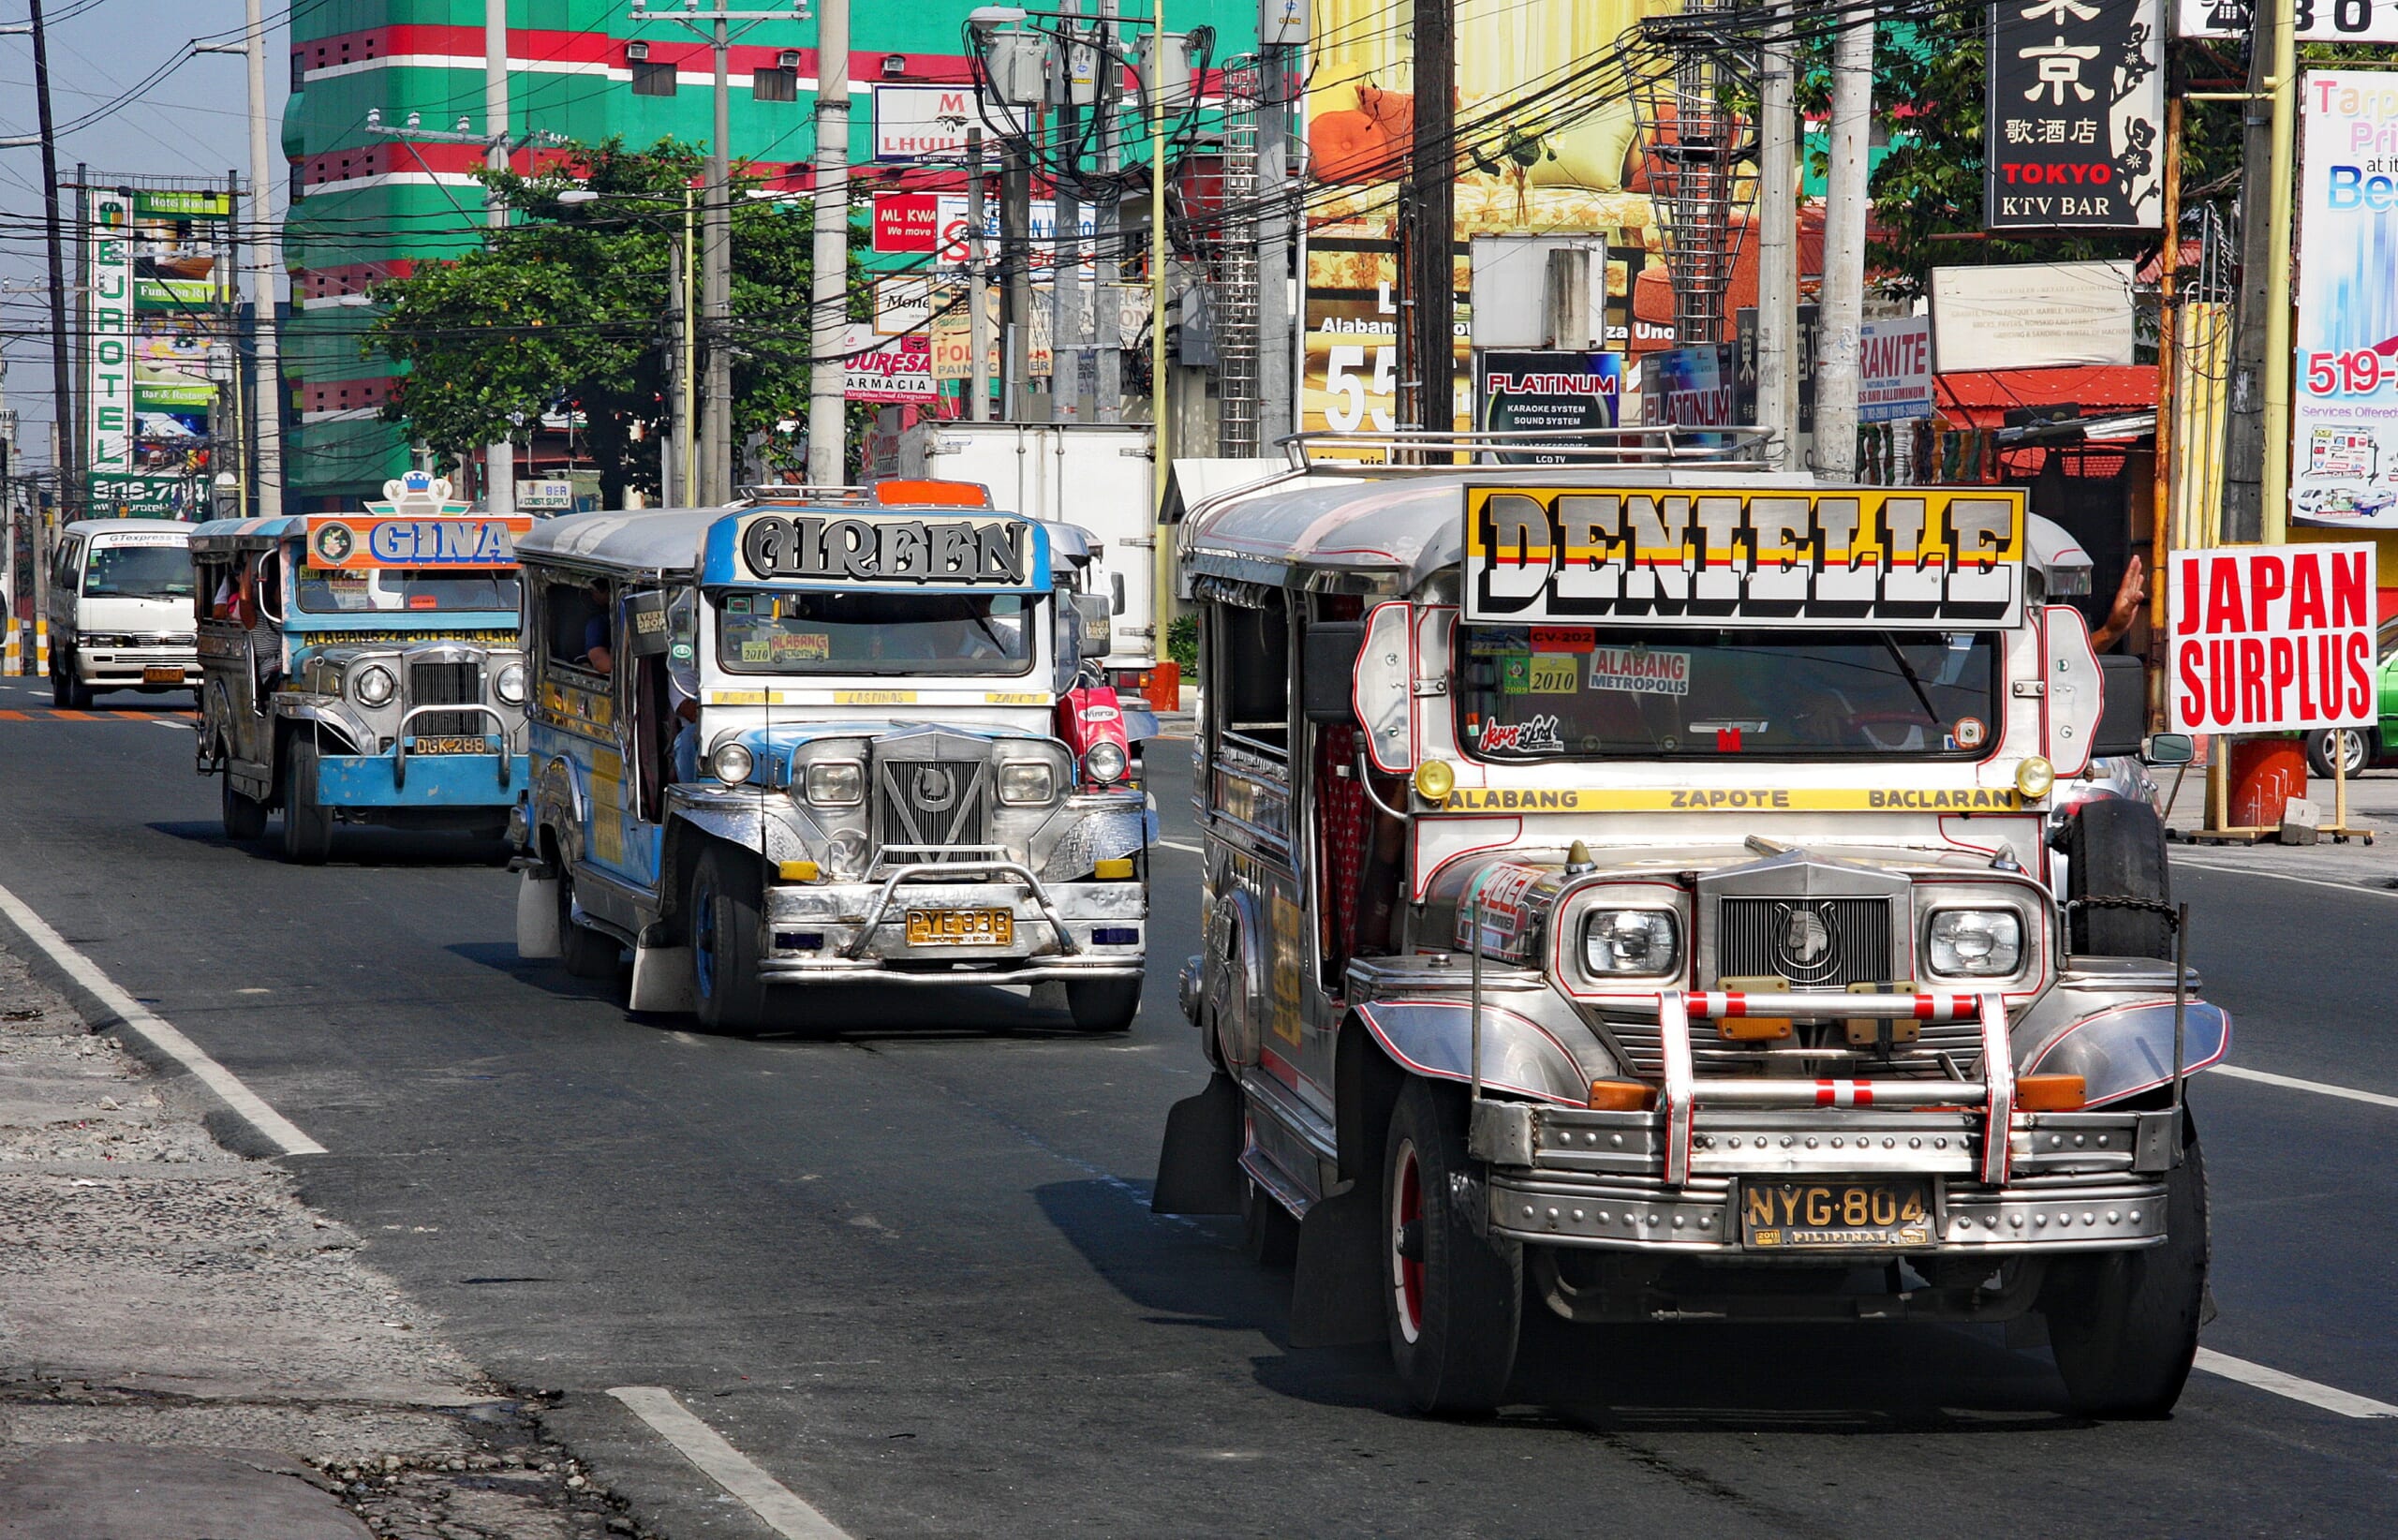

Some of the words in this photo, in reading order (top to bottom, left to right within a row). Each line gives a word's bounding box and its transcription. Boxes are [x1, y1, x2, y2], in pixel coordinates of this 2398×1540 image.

[939, 93, 966, 112] M
[2005, 117, 2098, 144] 歌酒店
[2367, 157, 2383, 172] at
[2002, 163, 2111, 185] TOKYO
[2329, 164, 2398, 210] Be
[150, 196, 179, 207] Hotel
[2003, 196, 2051, 216] KTV
[2061, 197, 2109, 216] BAR
[881, 209, 902, 222] ML
[887, 226, 902, 235] We
[141, 285, 189, 297] Funcion
[1320, 317, 1396, 333] Alaban
[1636, 322, 1674, 339] Uno
[938, 364, 973, 375] PAIN
[1488, 373, 1616, 395] PLATINUM
[141, 390, 157, 399] Bar
[1507, 405, 1548, 413] KARAOKE
[1643, 385, 1732, 427] PLATINUM
[2302, 407, 2352, 418] Services
[1535, 455, 1553, 464] LCD
[1555, 455, 1566, 464] TV
[370, 521, 514, 562] GINA
[1478, 494, 2012, 614] DENIELLE
[2177, 551, 2368, 635] JAPAN
[636, 610, 664, 620] EVERY
[638, 617, 665, 629] DROP
[1087, 626, 1110, 636] DROP
[1532, 632, 1591, 643] CV-202
[772, 635, 828, 648] ALABANG
[744, 649, 769, 660] 2010
[1595, 650, 1685, 680] ALABANG
[1532, 672, 1575, 690] 2010
[1591, 674, 1687, 694] METROPOLIS
[2180, 631, 2371, 728] SURPLUS
[1448, 791, 1578, 808] ALABANG
[1670, 791, 1790, 807] ZAPOTE
[1868, 790, 2013, 808] BACLARAN
[909, 911, 955, 933] PYE
[1792, 1231, 1889, 1244] PILIPINAS
